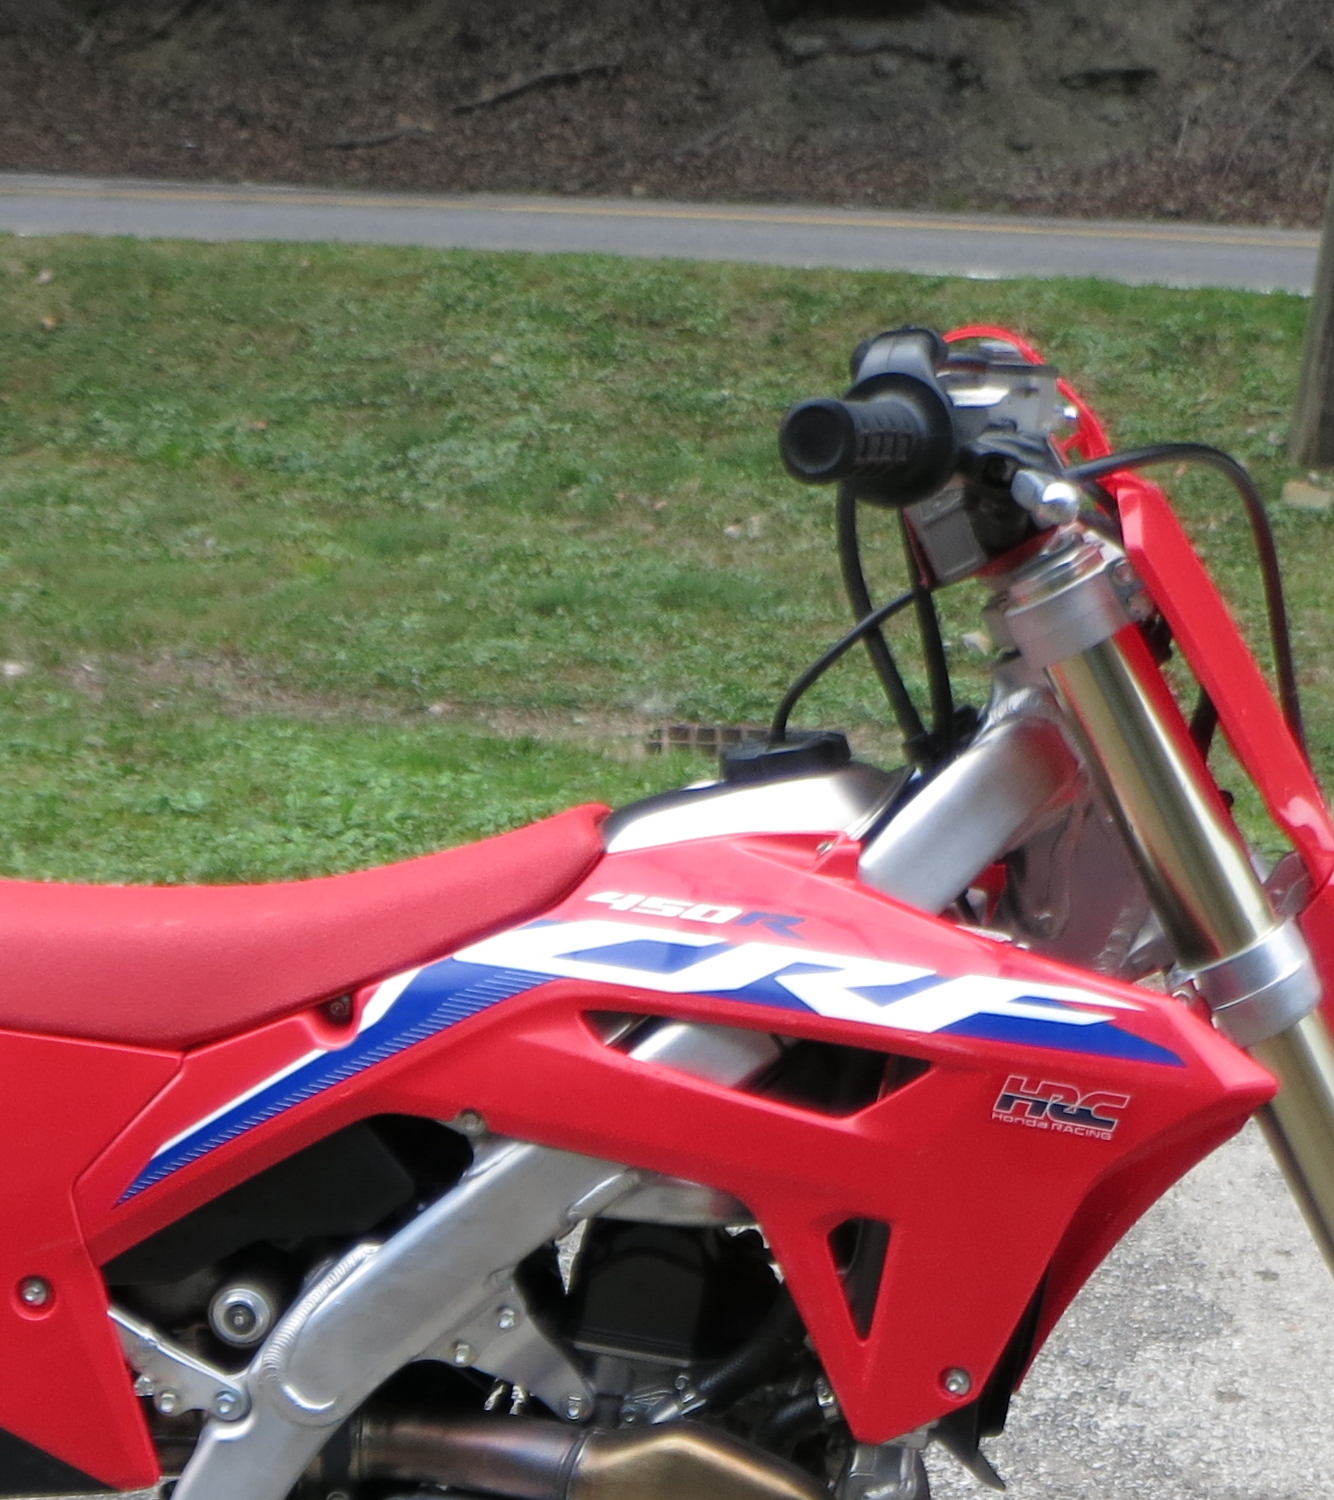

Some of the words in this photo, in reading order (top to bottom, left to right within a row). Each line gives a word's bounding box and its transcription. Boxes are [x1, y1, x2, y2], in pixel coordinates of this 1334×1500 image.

[585, 891, 806, 940] 450R
[453, 920, 1146, 1033] CRF
[991, 1111, 1049, 1130] Honda
[1050, 1121, 1113, 1141] RACING
[993, 1075, 1131, 1132] HRC
